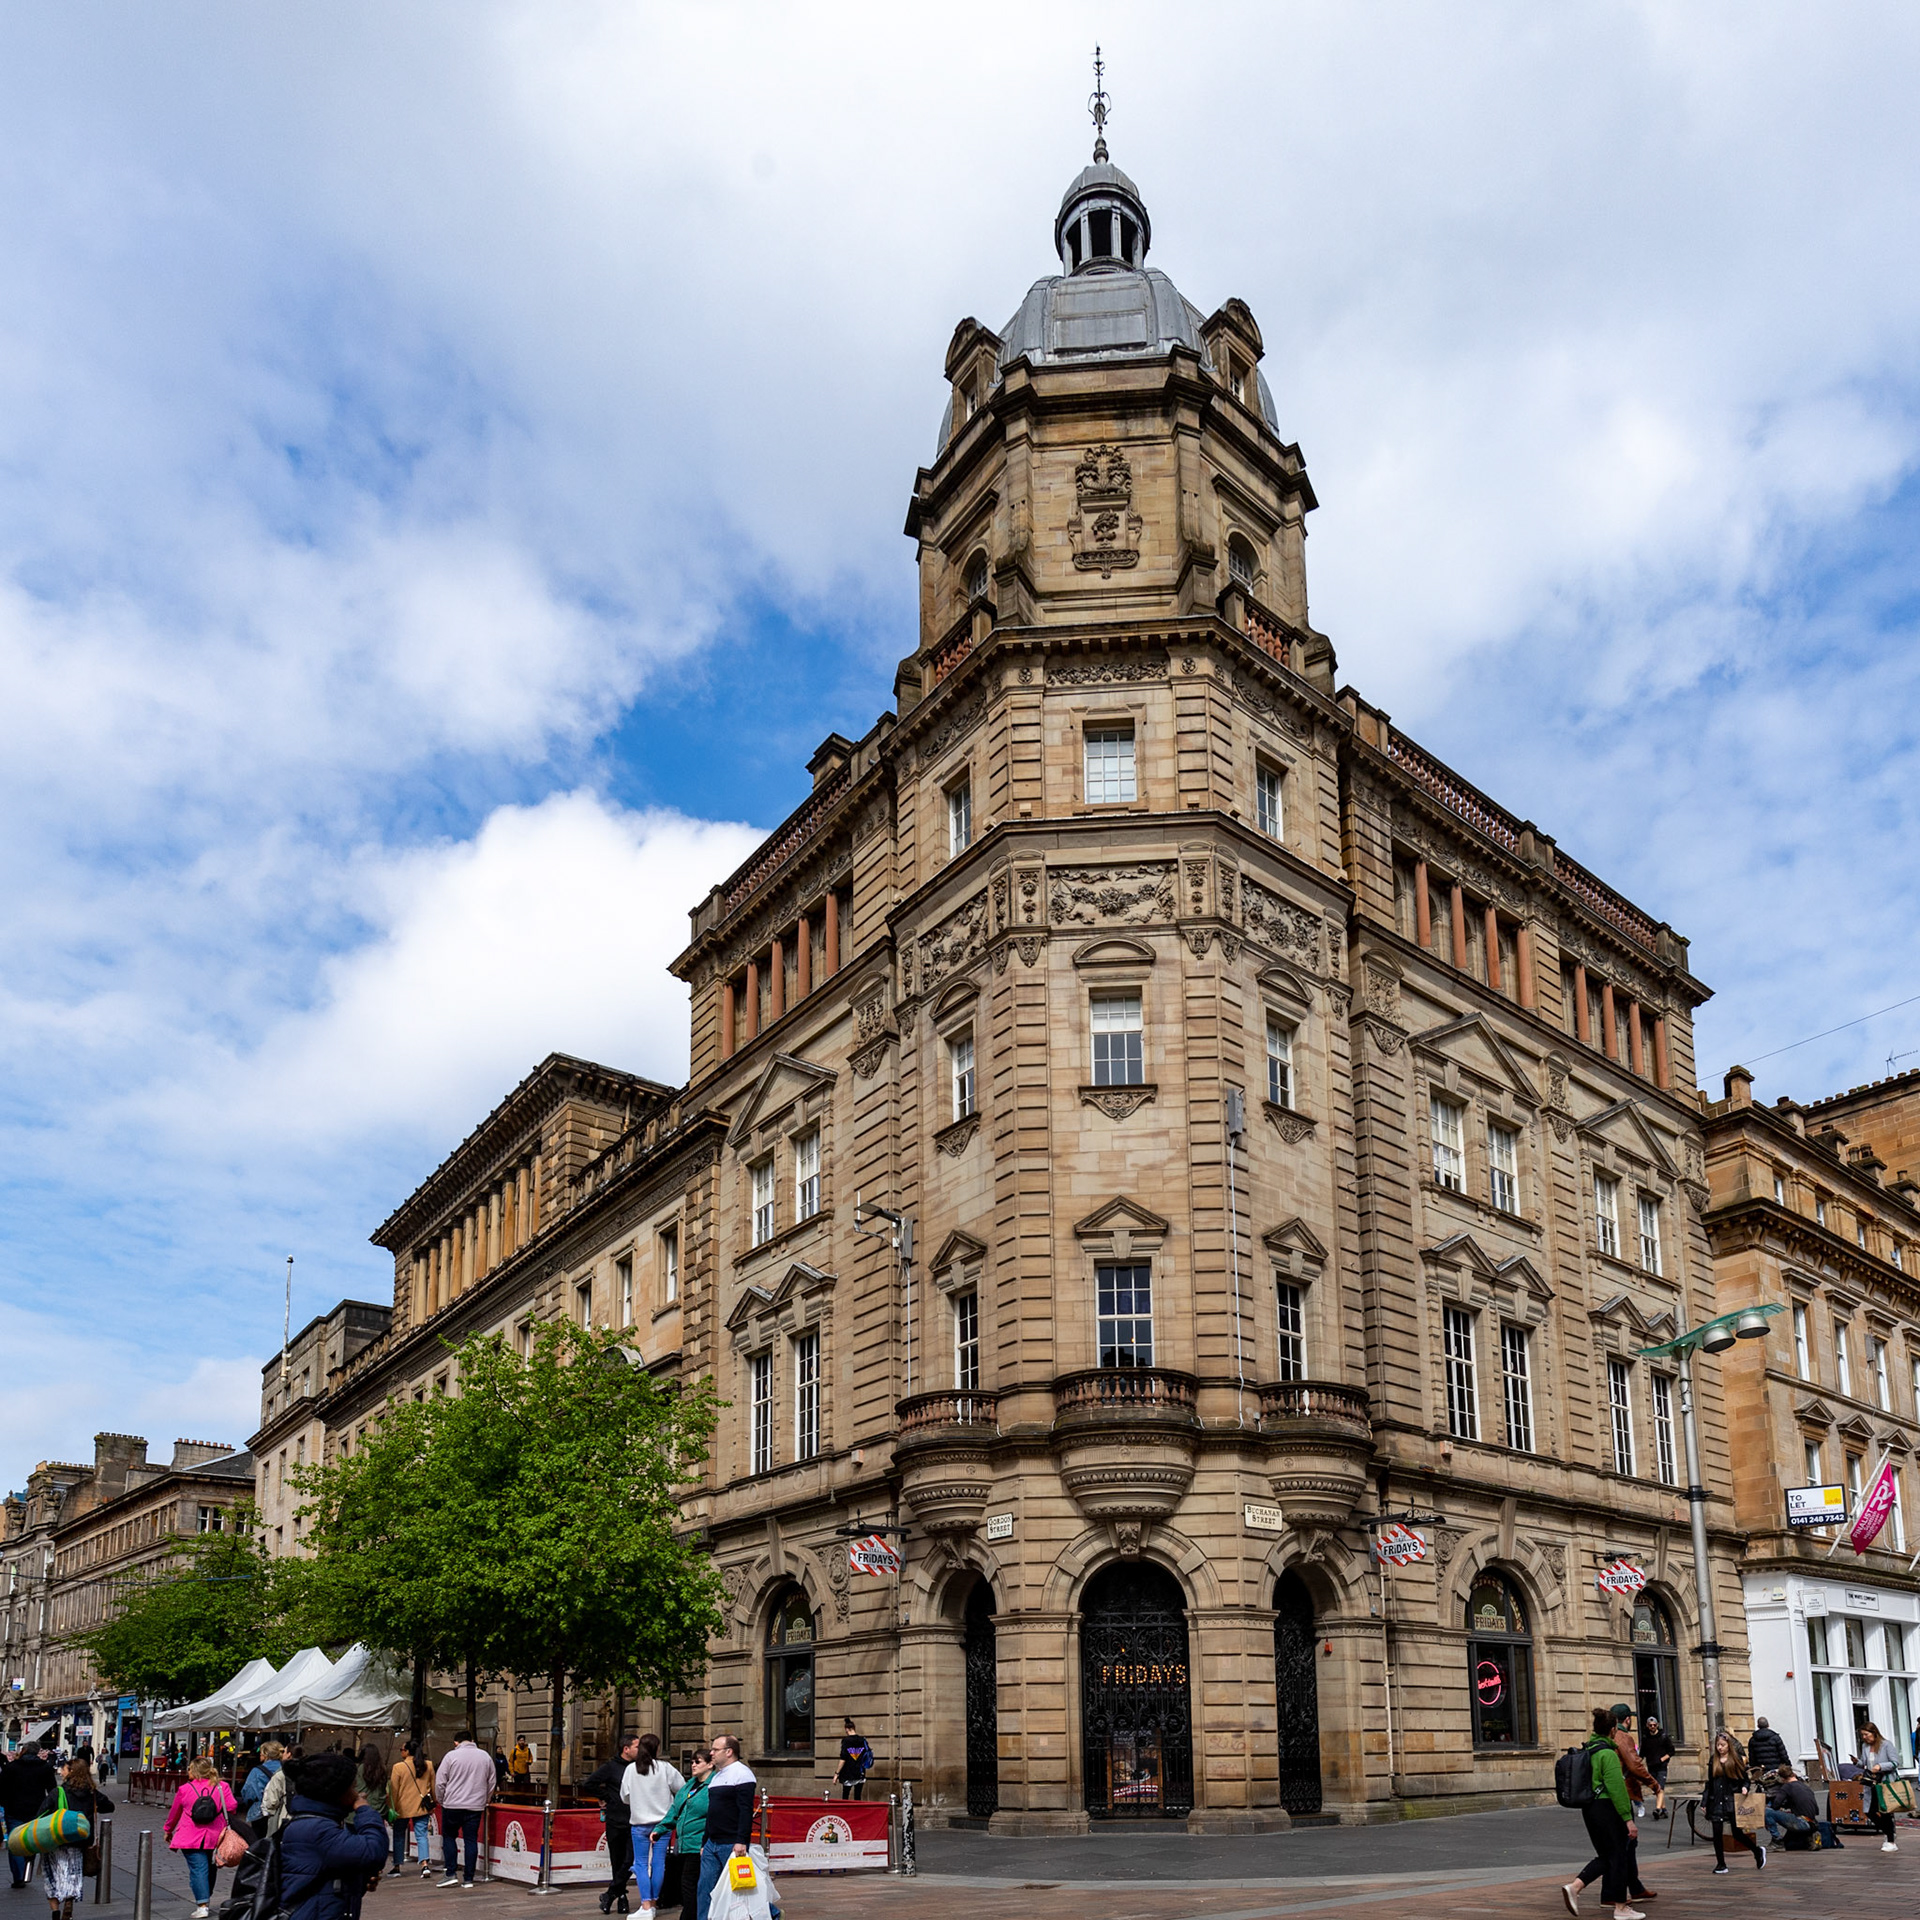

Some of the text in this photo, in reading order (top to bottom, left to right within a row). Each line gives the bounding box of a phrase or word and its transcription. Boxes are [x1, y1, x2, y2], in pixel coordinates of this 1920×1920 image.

[1247, 1506, 1280, 1517] BUCHANAN
[989, 1516, 1011, 1525] GORDON
[1252, 1515, 1276, 1525] STREET
[1825, 1514, 1845, 1522] 7342
[1853, 1508, 1874, 1538] FINALIST
[990, 1524, 1011, 1534] STREET
[808, 1817, 850, 1843] BIRRA MORETTI
